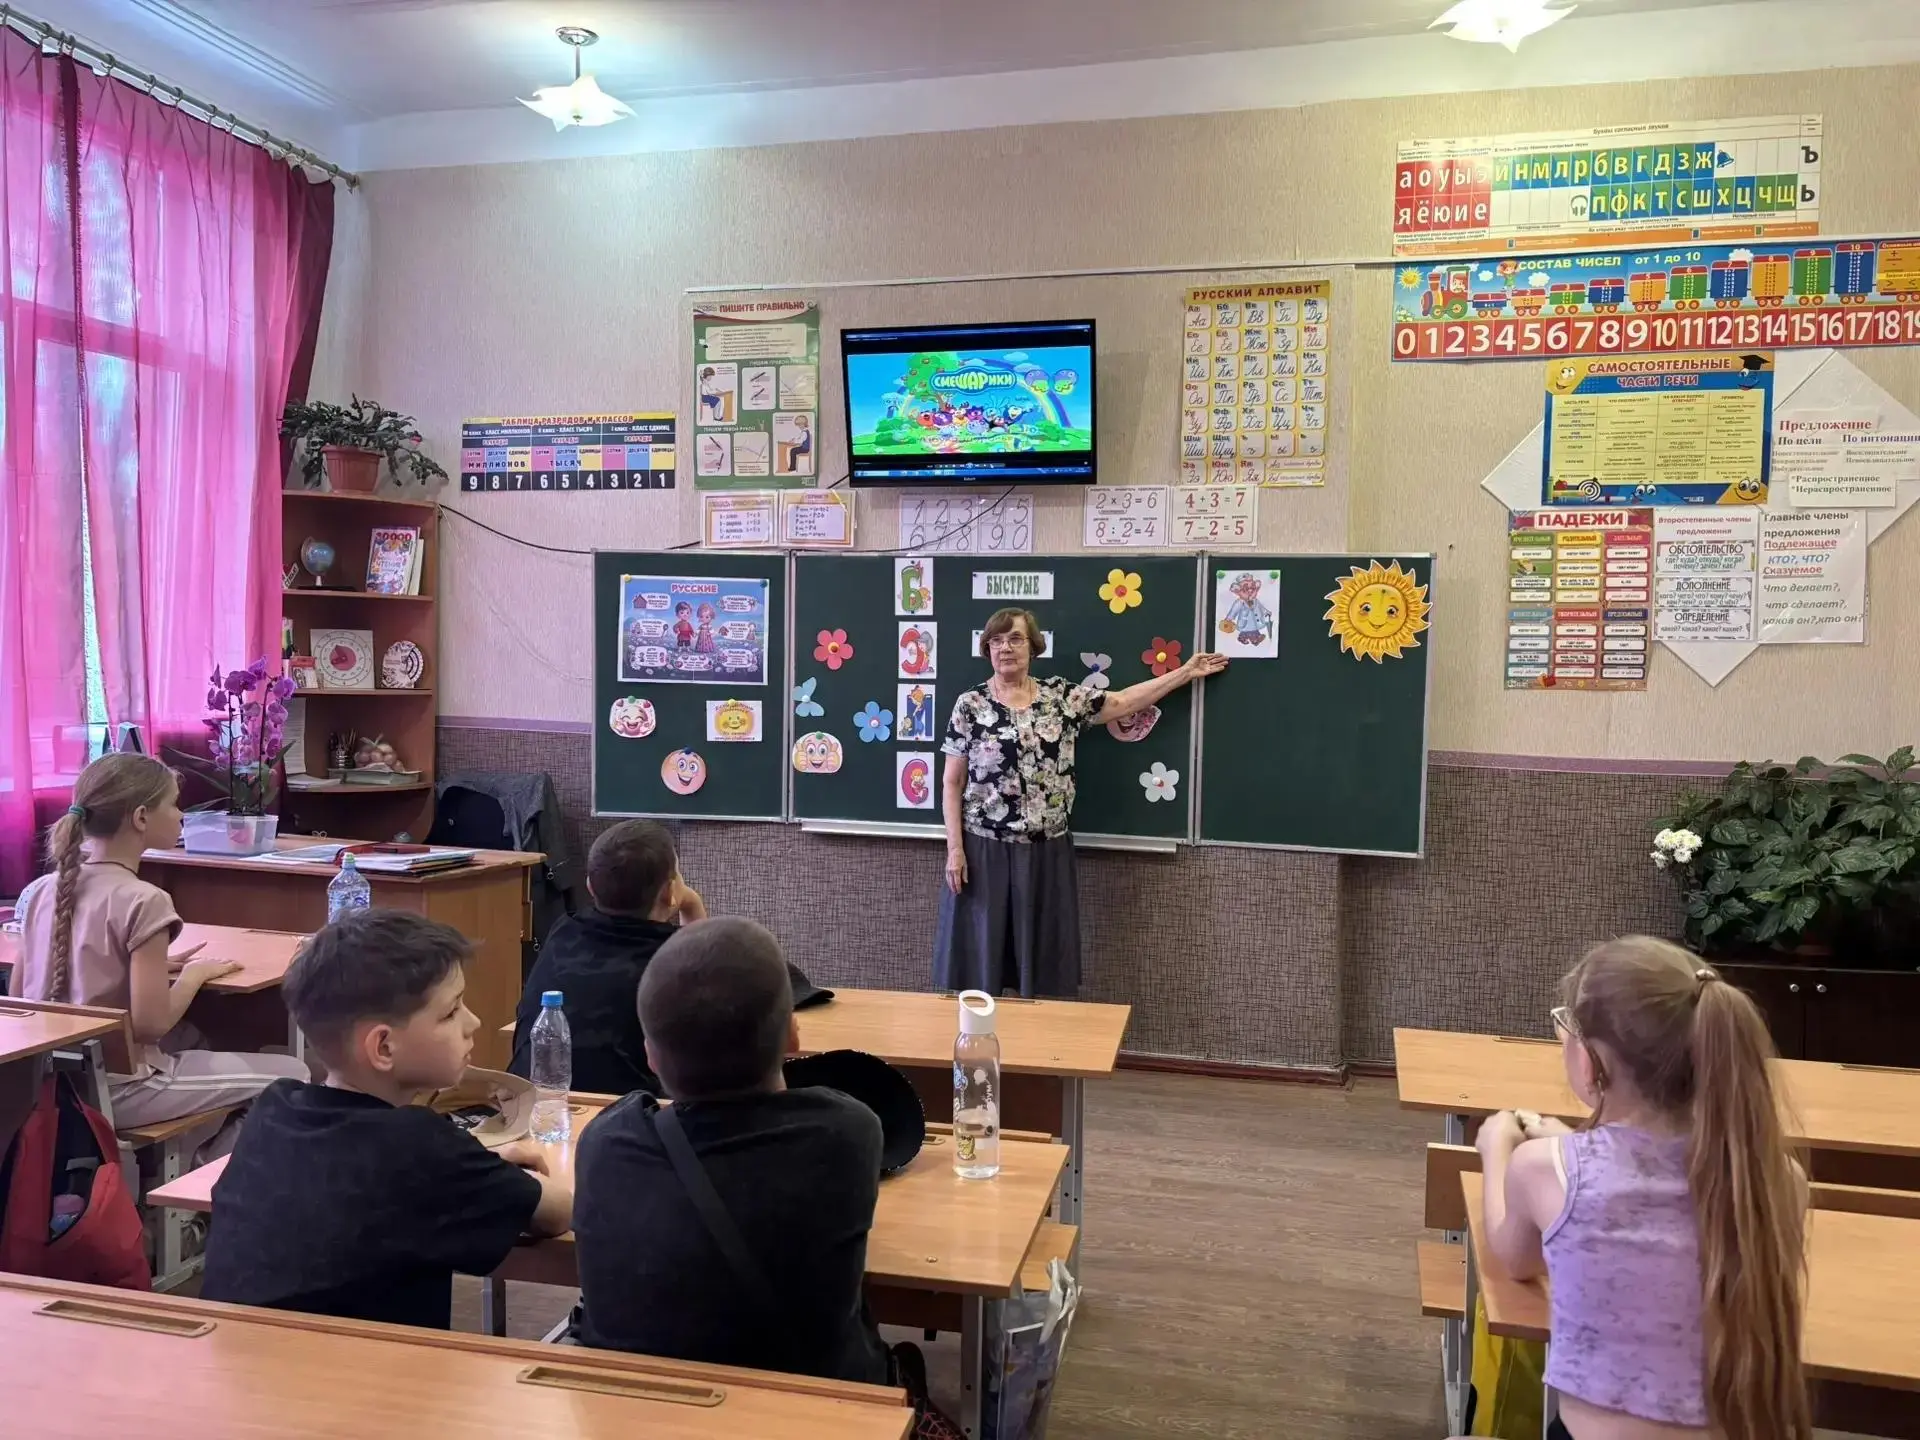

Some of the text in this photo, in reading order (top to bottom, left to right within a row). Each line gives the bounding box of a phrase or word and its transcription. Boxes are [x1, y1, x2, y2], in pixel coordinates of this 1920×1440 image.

[1519, 251, 1701, 270] СОСТАВ ЧИСЕЛ от 1 до 10
[1193, 284, 1321, 300] РУССКИЙ АЛФАВИТ
[719, 302, 805, 313] ПИШИТЕ ПРАВИЛЬНО
[1397, 328, 1416, 355] 0
[1425, 328, 1436, 354] 1
[1445, 326, 1465, 353] 2
[1471, 325, 1489, 352] 3
[1495, 325, 1517, 352] 4
[1521, 323, 1541, 351] 5
[1546, 322, 1567, 350] 6
[1574, 322, 1594, 349] 7
[1599, 320, 1621, 348] 8
[1626, 319, 1648, 348] 9
[1652, 318, 1677, 347] 10
[1679, 317, 1705, 346] 11
[1707, 315, 1732, 345] 12
[1735, 314, 1760, 344] 13
[1762, 314, 1788, 343] 14
[1790, 313, 1816, 342] 15
[1818, 312, 1844, 341] 16
[1846, 311, 1873, 341] 17
[1874, 310, 1900, 340] 18
[1587, 359, 1730, 374] САМОСТОЯТЕЛЬНЫЕ
[1617, 375, 1698, 388] ЧАСТИ РЕЧИ
[502, 417, 539, 426] ТАБЛИЦА
[541, 417, 584, 425] РАЗРЯДОВ
[596, 415, 634, 423] КЛАССОВ
[1779, 420, 1872, 433] Предложение
[1778, 437, 1822, 446] По цели
[1842, 434, 1859, 443] По
[470, 473, 665, 490] 9 8 7 6 5 4 3 2 1
[1185, 492, 1245, 508] 4 3 7
[915, 500, 924, 525] 1
[935, 499, 949, 525] 2
[958, 499, 972, 525] 3
[1013, 498, 1029, 524] 5
[1763, 512, 1849, 522] Главные члены
[1538, 512, 1624, 529] ПАДЕЖИ
[1658, 517, 1724, 525] Второстепенные
[1185, 520, 1244, 536] 7 2 5
[1676, 528, 1732, 536] предложения
[1764, 528, 1841, 539] предложения
[957, 526, 971, 551] 8
[988, 525, 1004, 550] 9
[1013, 525, 1028, 550] 0
[1669, 544, 1743, 555] ОБСТОЯТЕЛЬСТВО
[1764, 540, 1837, 550] Подлежащее
[1763, 566, 1823, 576] Сказуемое
[671, 583, 718, 593] РУССКИЕ
[986, 574, 1040, 595] БЫСТРЫЕ
[1676, 581, 1730, 591] ДОПОЛНЕНИЕ
[1764, 584, 1789, 592] Что
[1766, 601, 1788, 609] что
[1674, 612, 1730, 622] ОПРЕДЕЛЕНИЕ
